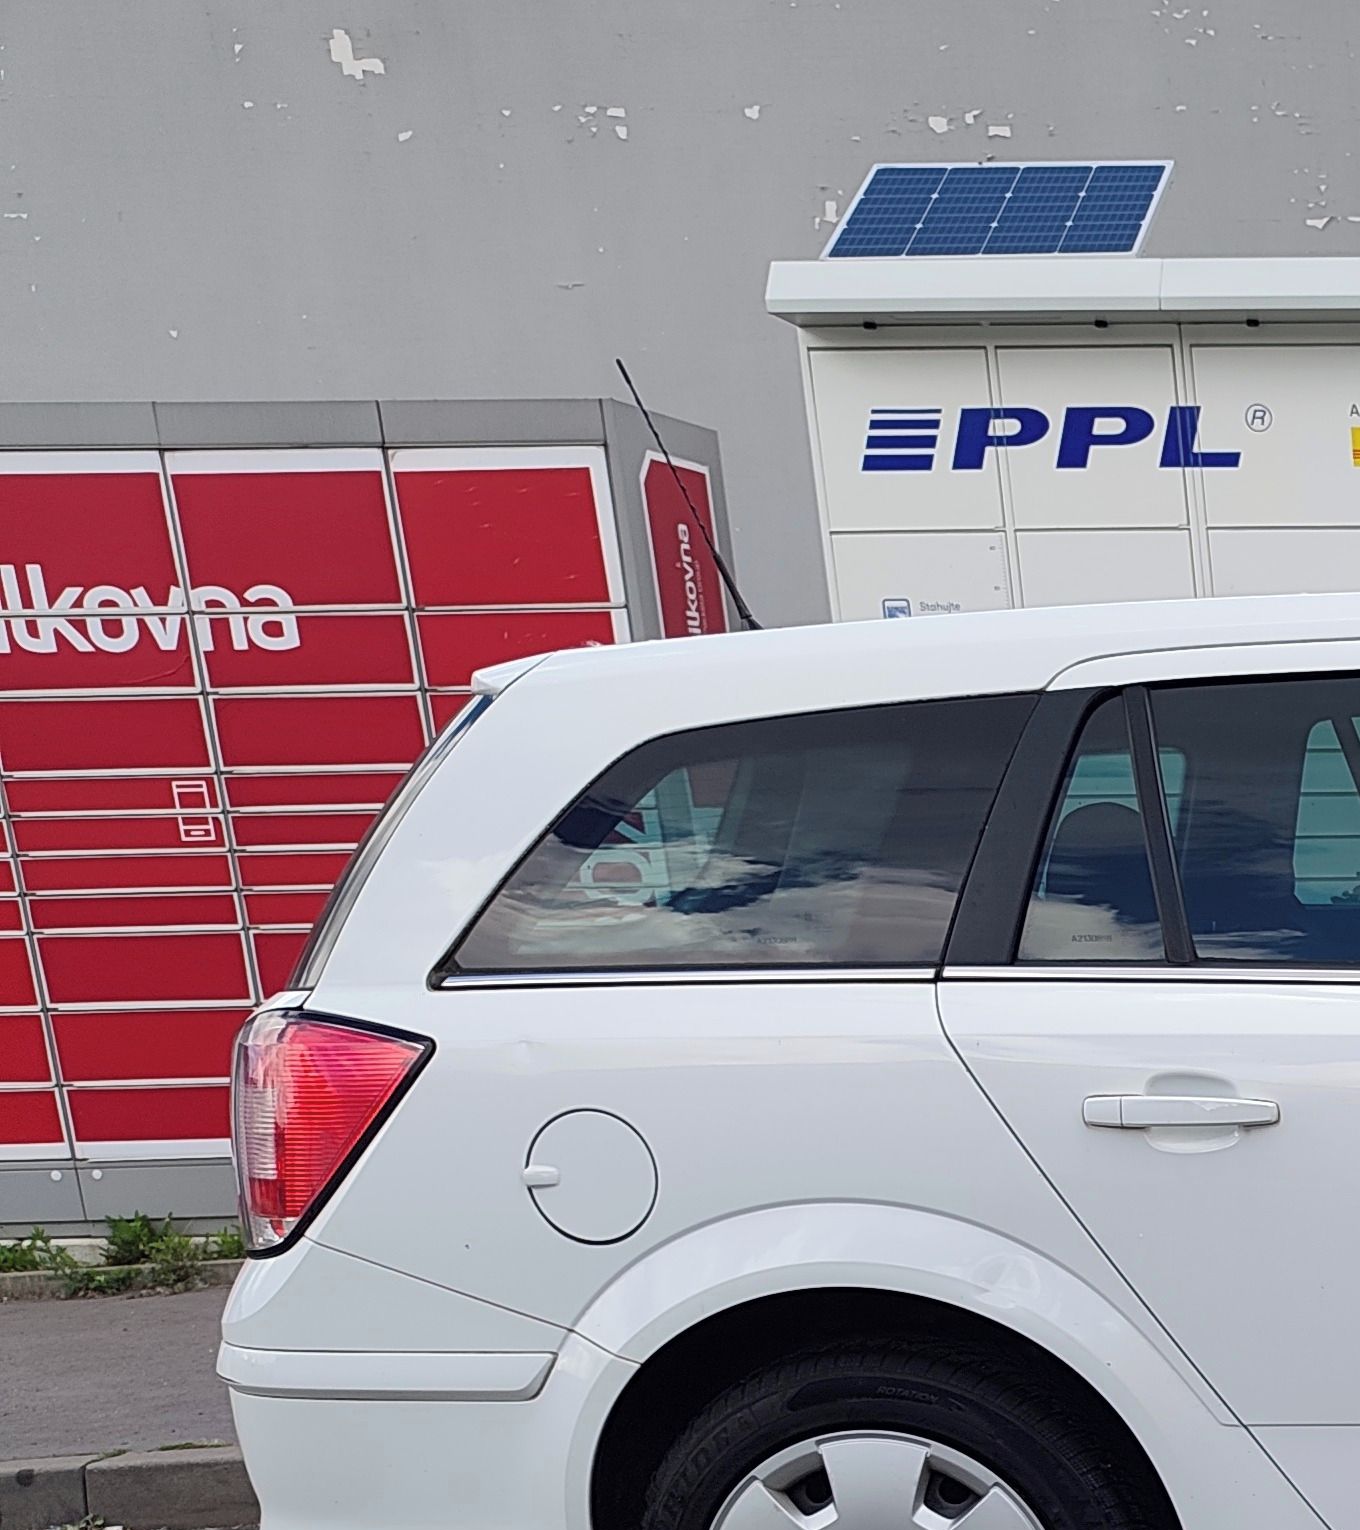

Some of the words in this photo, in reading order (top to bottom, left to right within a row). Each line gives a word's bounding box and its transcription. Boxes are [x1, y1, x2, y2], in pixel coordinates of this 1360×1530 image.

[951, 405, 1242, 470] PPL
[1350, 404, 1360, 417] A
[0, 563, 301, 654] lkovna
